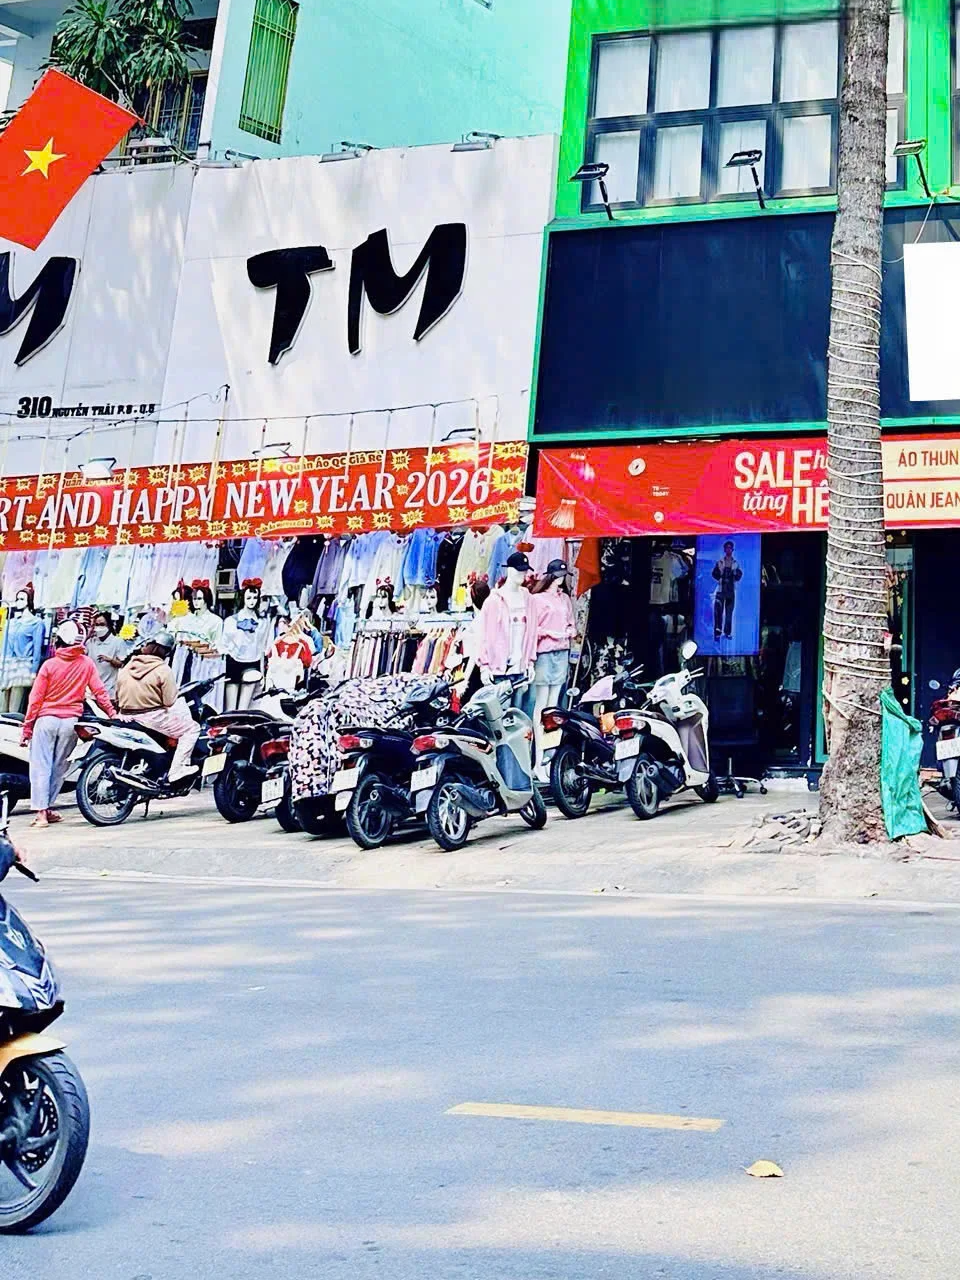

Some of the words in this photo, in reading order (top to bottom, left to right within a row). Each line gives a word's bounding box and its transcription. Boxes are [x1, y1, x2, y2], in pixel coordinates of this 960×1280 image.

[247, 222, 468, 365] TM
[16, 396, 53, 418] 310
[734, 449, 813, 489] SALE
[898, 449, 918, 467] ÁO
[921, 449, 959, 466] THUN
[500, 473, 519, 485] 125k
[36, 491, 101, 529] AND
[109, 483, 217, 526] HAPPY
[223, 478, 300, 520] NEW
[308, 472, 396, 514] YEAR
[404, 467, 491, 509] 2026
[743, 490, 788, 516] tặng
